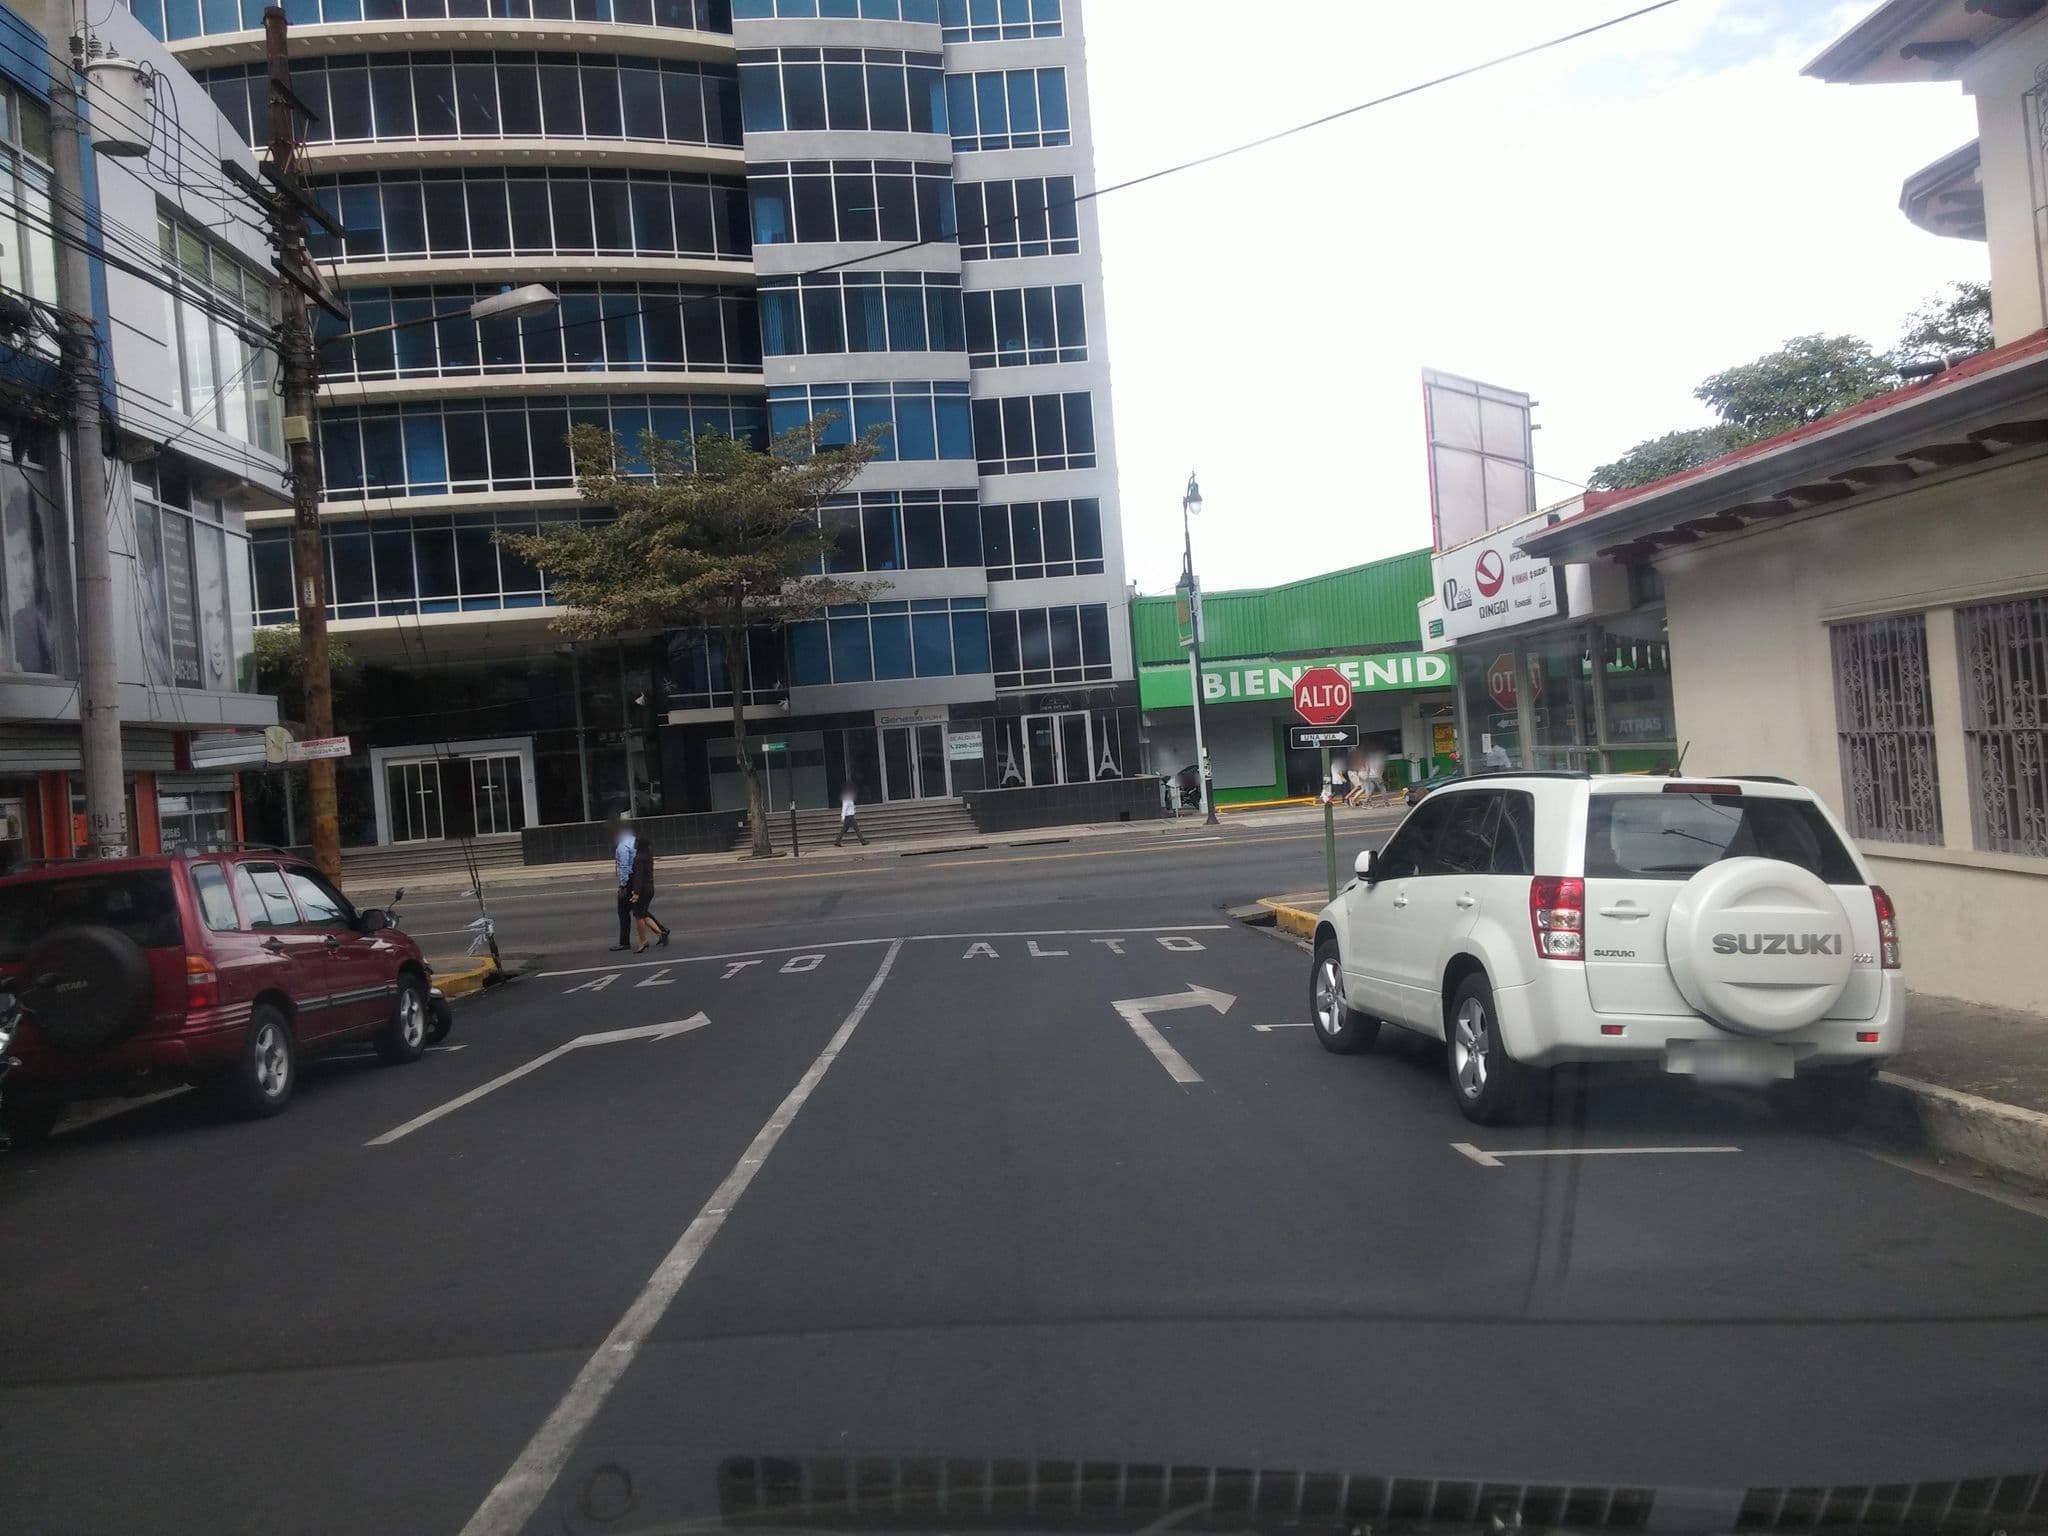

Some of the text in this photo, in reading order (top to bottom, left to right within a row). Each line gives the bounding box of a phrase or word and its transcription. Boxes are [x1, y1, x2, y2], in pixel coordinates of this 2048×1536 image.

[1479, 600, 1510, 619] QINGQI
[1204, 656, 1447, 700] BIENENID
[1299, 684, 1348, 708] ALTO
[1304, 734, 1320, 742] UNA
[962, 936, 1207, 959] ALTO
[1593, 949, 1636, 958] SUZUKI
[1712, 933, 1842, 955] SUZUKI
[562, 953, 827, 994] ALTO
